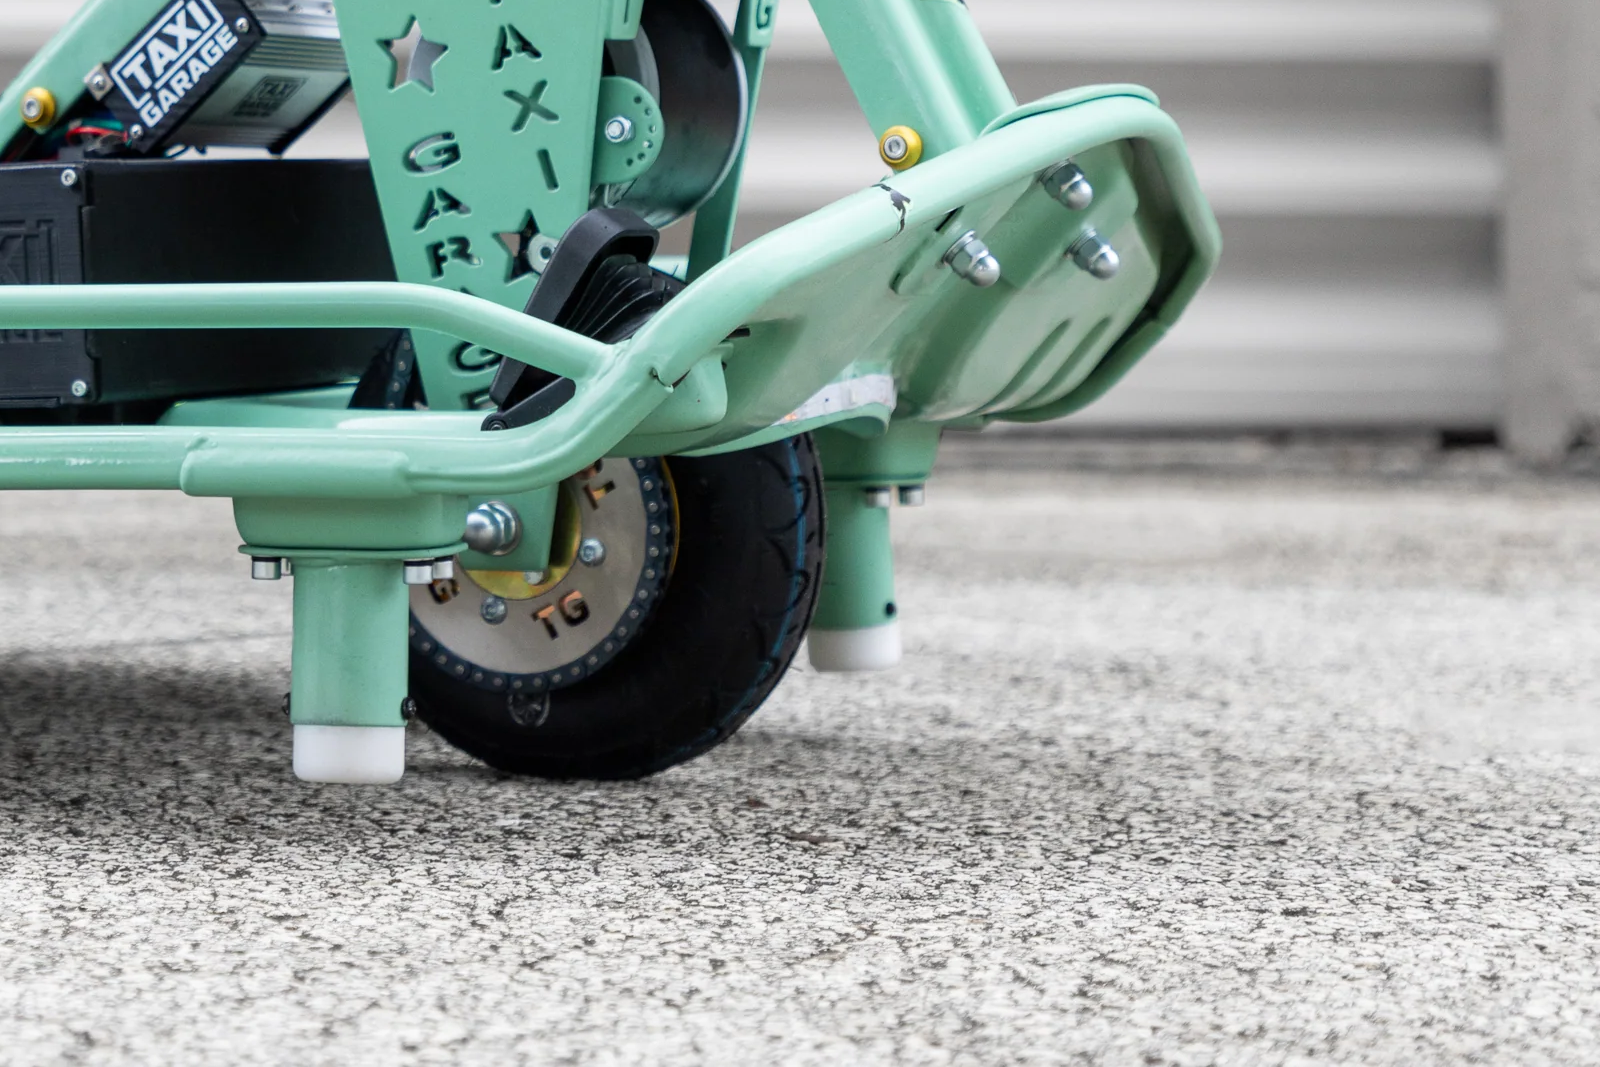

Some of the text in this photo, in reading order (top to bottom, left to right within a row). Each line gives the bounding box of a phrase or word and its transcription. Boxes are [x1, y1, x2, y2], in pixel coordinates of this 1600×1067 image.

[121, 0, 211, 90] TAXI
[138, 23, 239, 128] GARAGE
[402, 131, 502, 411] GARG
[531, 589, 591, 641] TG
